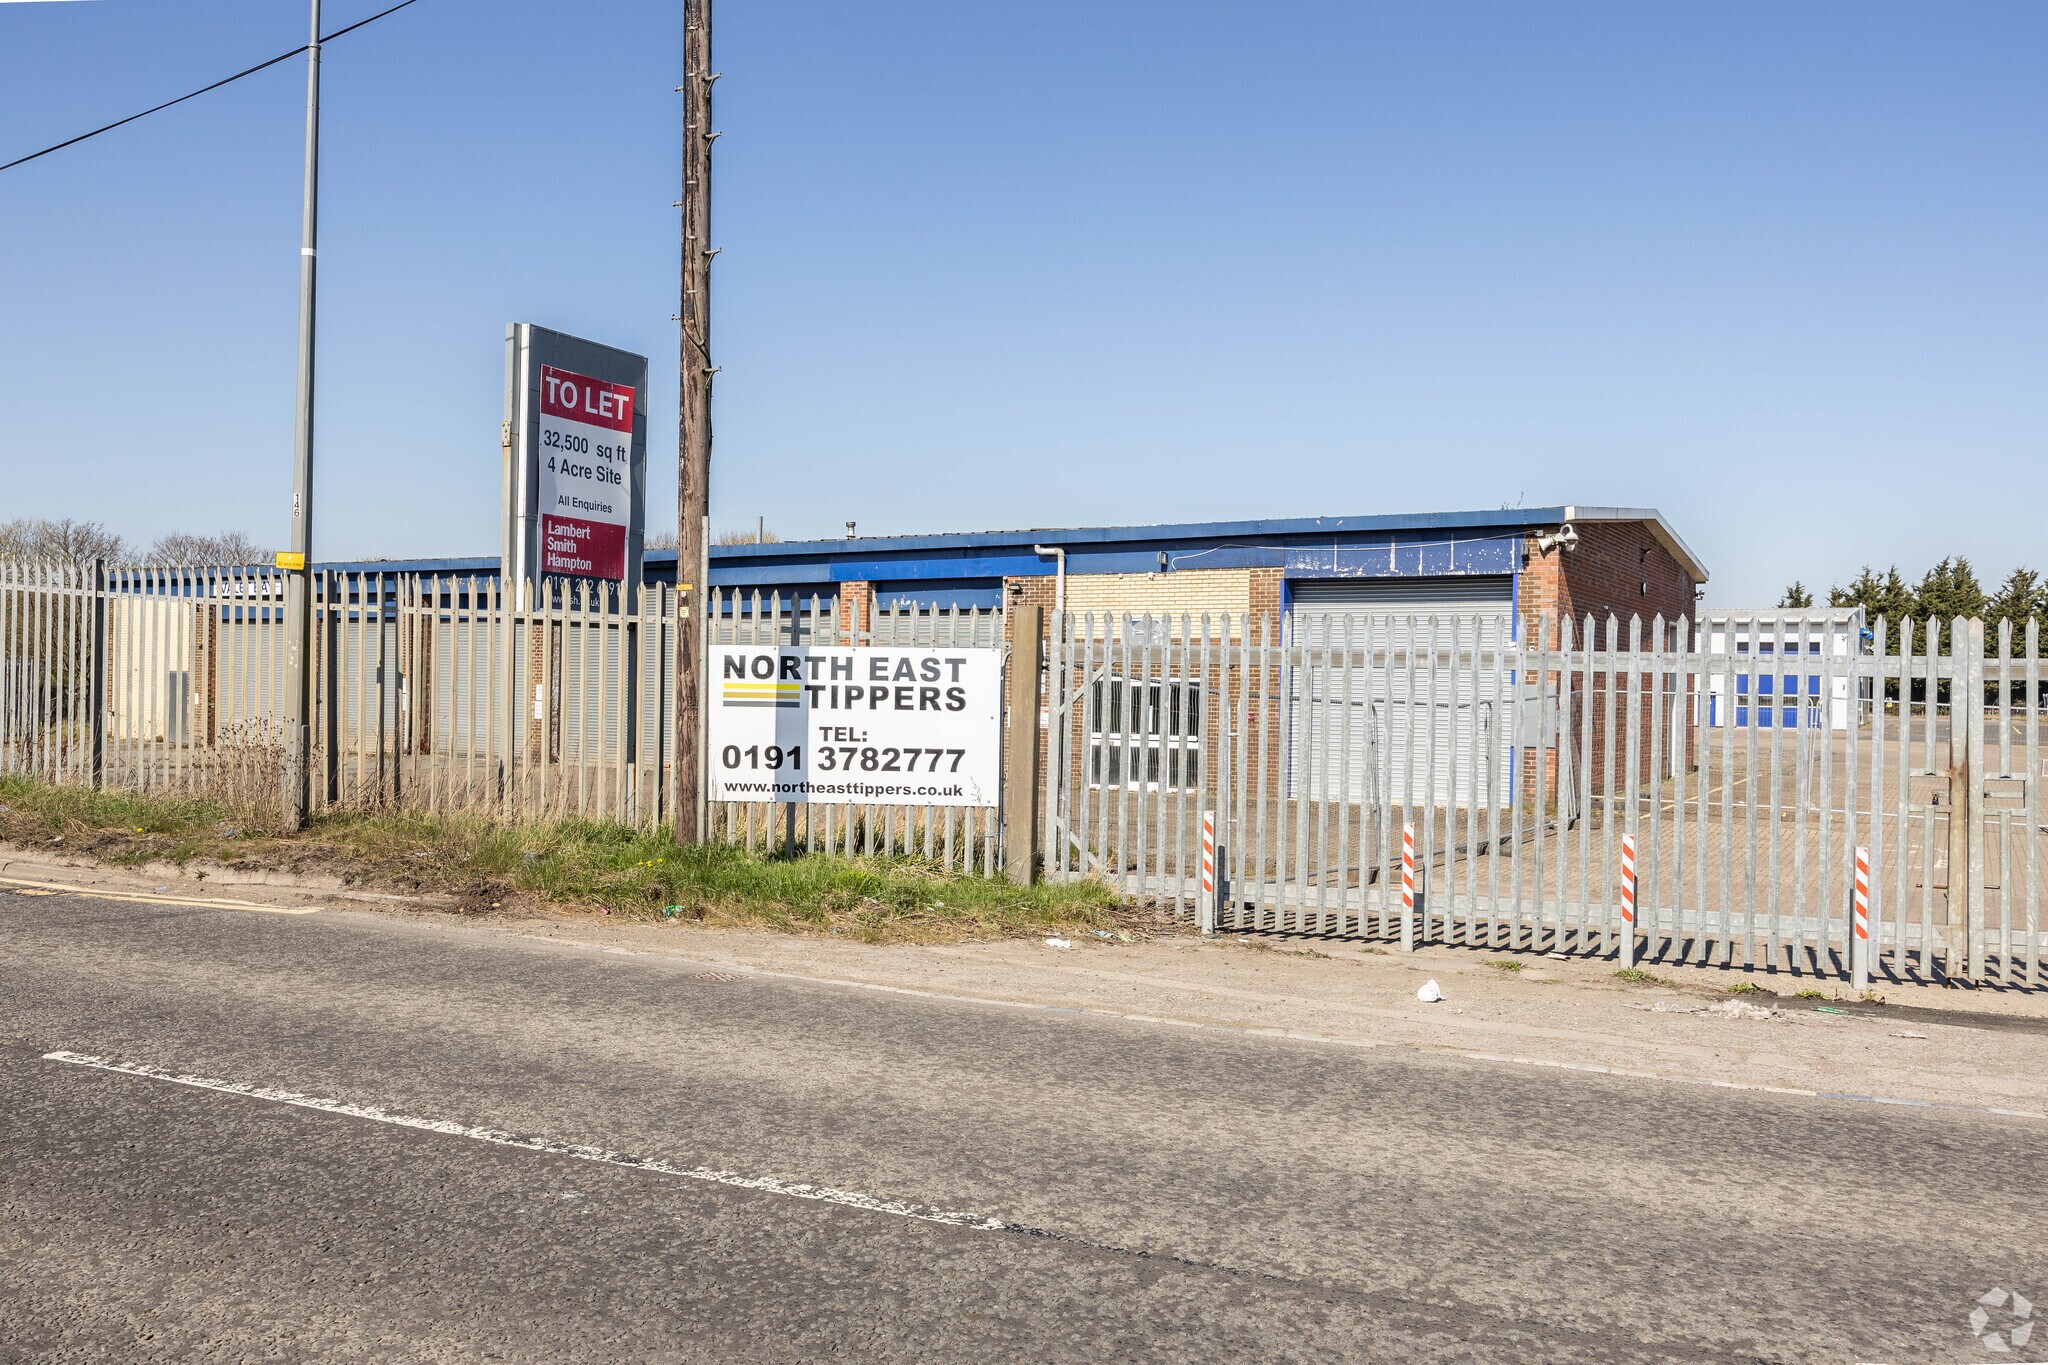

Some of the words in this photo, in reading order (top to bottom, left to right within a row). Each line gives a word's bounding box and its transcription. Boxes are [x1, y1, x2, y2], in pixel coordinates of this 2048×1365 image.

[545, 376, 578, 409] TO
[585, 386, 630, 420] LET
[544, 429, 589, 454] 32,500
[596, 444, 612, 463] sq
[616, 445, 626, 462] ft
[547, 456, 556, 472] 4
[560, 459, 592, 479] Acre
[596, 466, 622, 485] Site
[558, 495, 570, 506] All
[572, 497, 613, 513] Enquiries
[547, 520, 591, 539] Lambert
[547, 537, 577, 553] Smith
[547, 552, 592, 571] Hampton
[575, 578, 594, 594] 22
[723, 655, 853, 680] NORTH
[869, 657, 967, 682] EAST
[804, 685, 967, 712] TIPPERS
[819, 726, 868, 742] TEL:
[722, 745, 800, 770] 0191
[817, 746, 966, 773] 3782777
[724, 781, 964, 797] www.northeasttippers.co.uk
